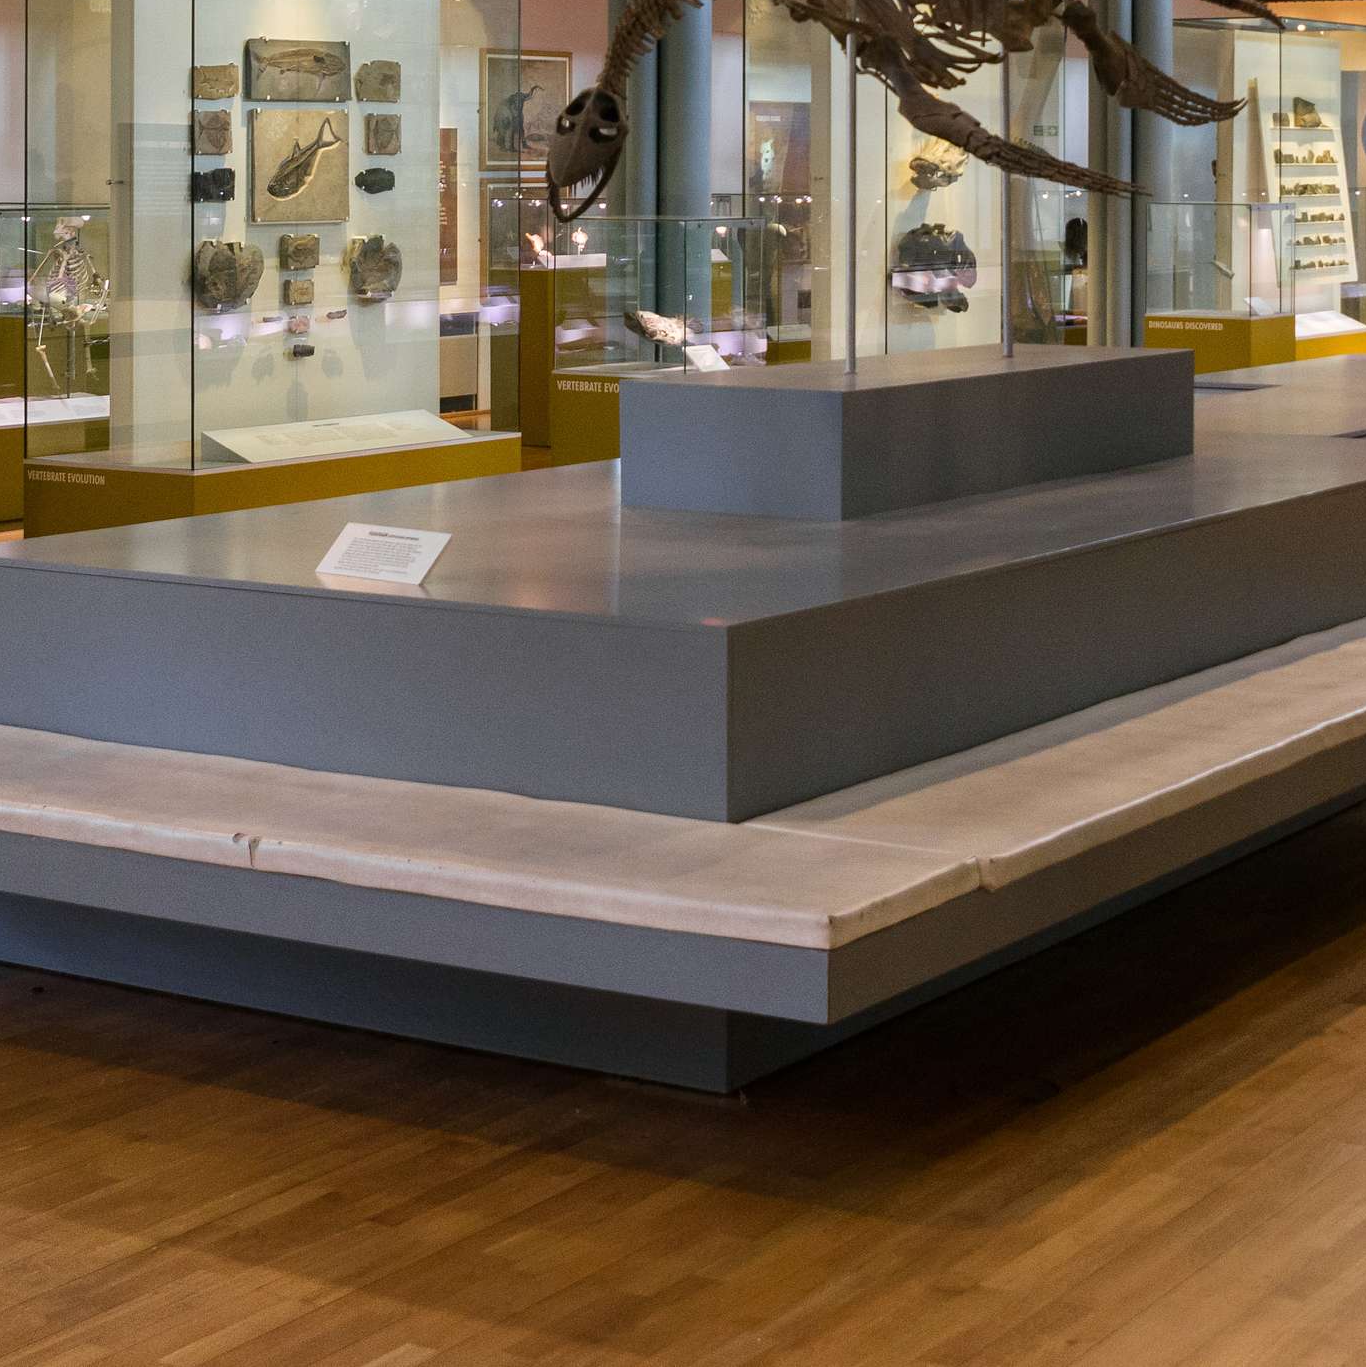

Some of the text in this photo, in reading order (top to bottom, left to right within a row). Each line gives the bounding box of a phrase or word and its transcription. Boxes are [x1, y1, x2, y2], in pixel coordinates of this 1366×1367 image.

[1148, 320, 1224, 331] DINOSAURS DISCOVERED
[556, 380, 602, 393] VERTEBRATE
[27, 469, 106, 486] VERTEBRATE EVOLUTION
